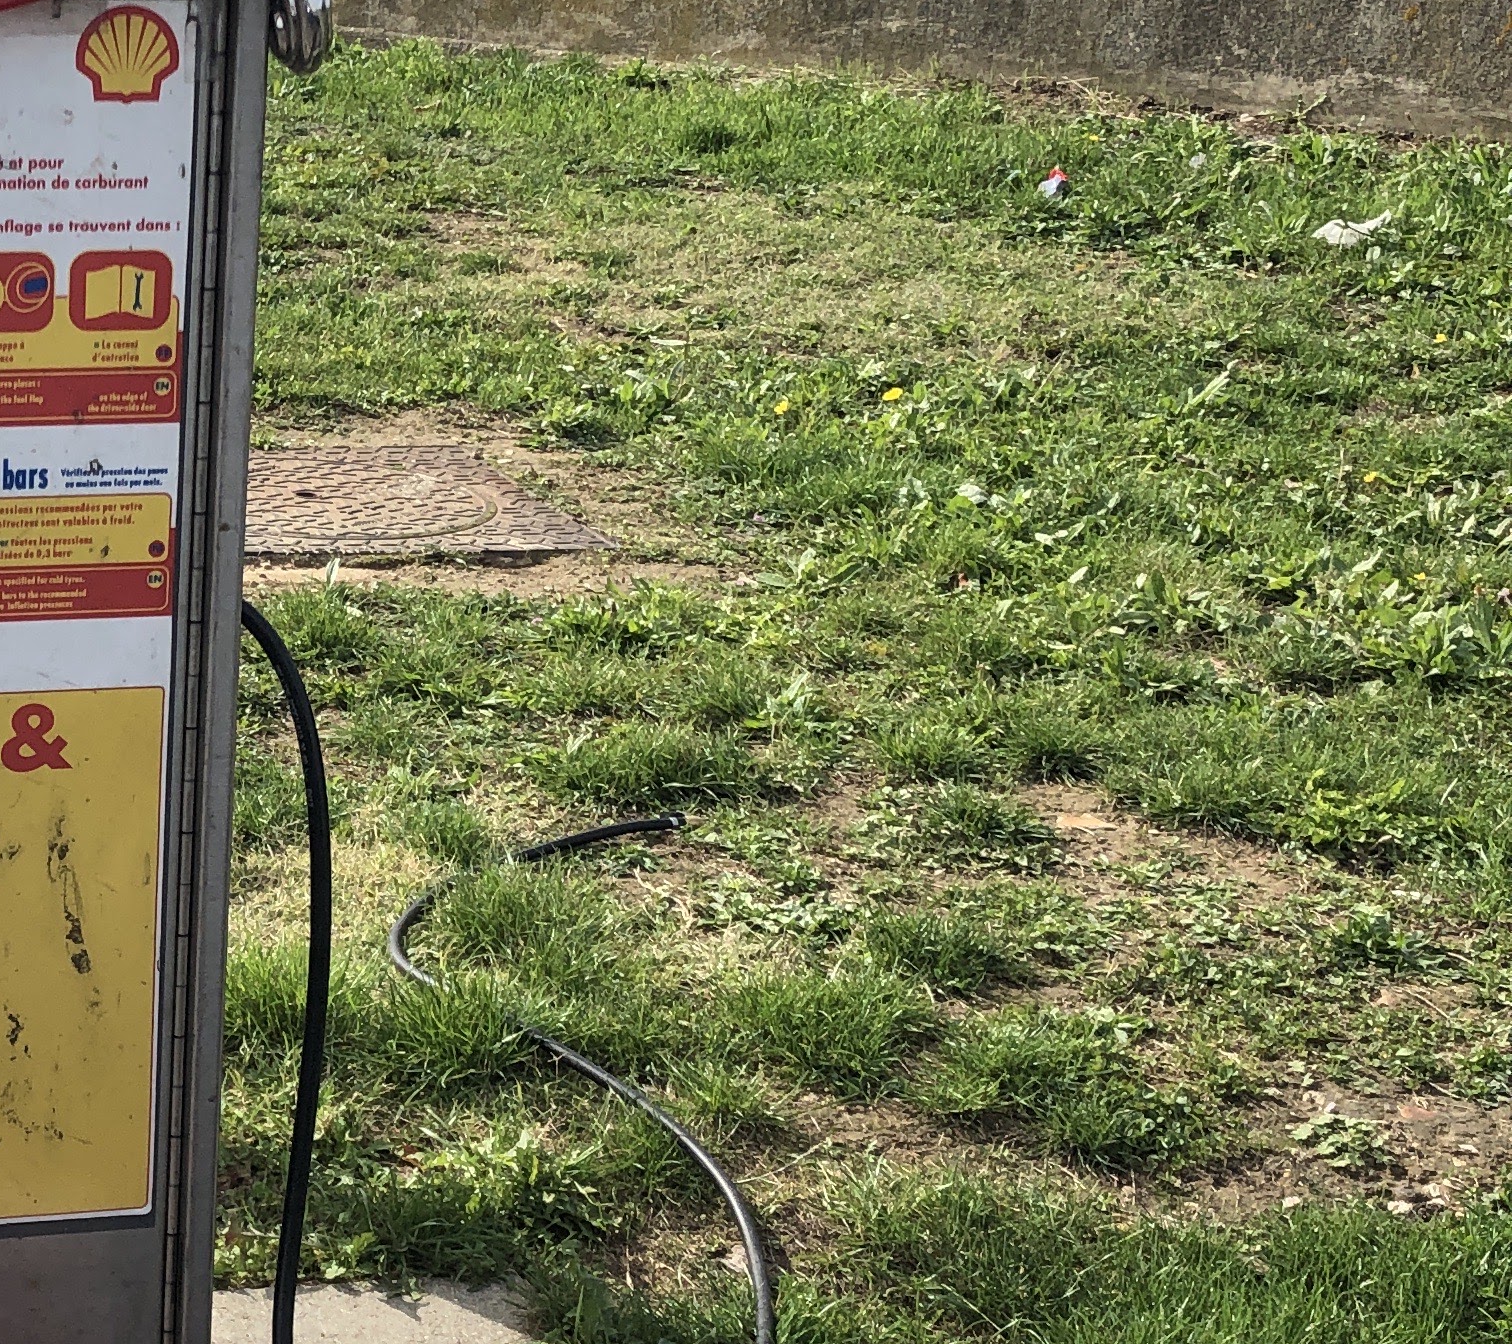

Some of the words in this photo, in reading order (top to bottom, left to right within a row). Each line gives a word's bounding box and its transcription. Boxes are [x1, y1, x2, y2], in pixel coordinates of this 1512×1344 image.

[28, 158, 64, 173] pour
[51, 175, 70, 190] de
[75, 174, 149, 189] carburant
[48, 222, 64, 232] se
[69, 220, 131, 232] trouvent
[136, 217, 171, 232] dans
[2, 458, 49, 491] bars
[36, 502, 100, 515] recommandées
[102, 503, 117, 514] par
[120, 502, 143, 512] votre
[148, 575, 162, 583] EN
[0, 703, 73, 773] &
